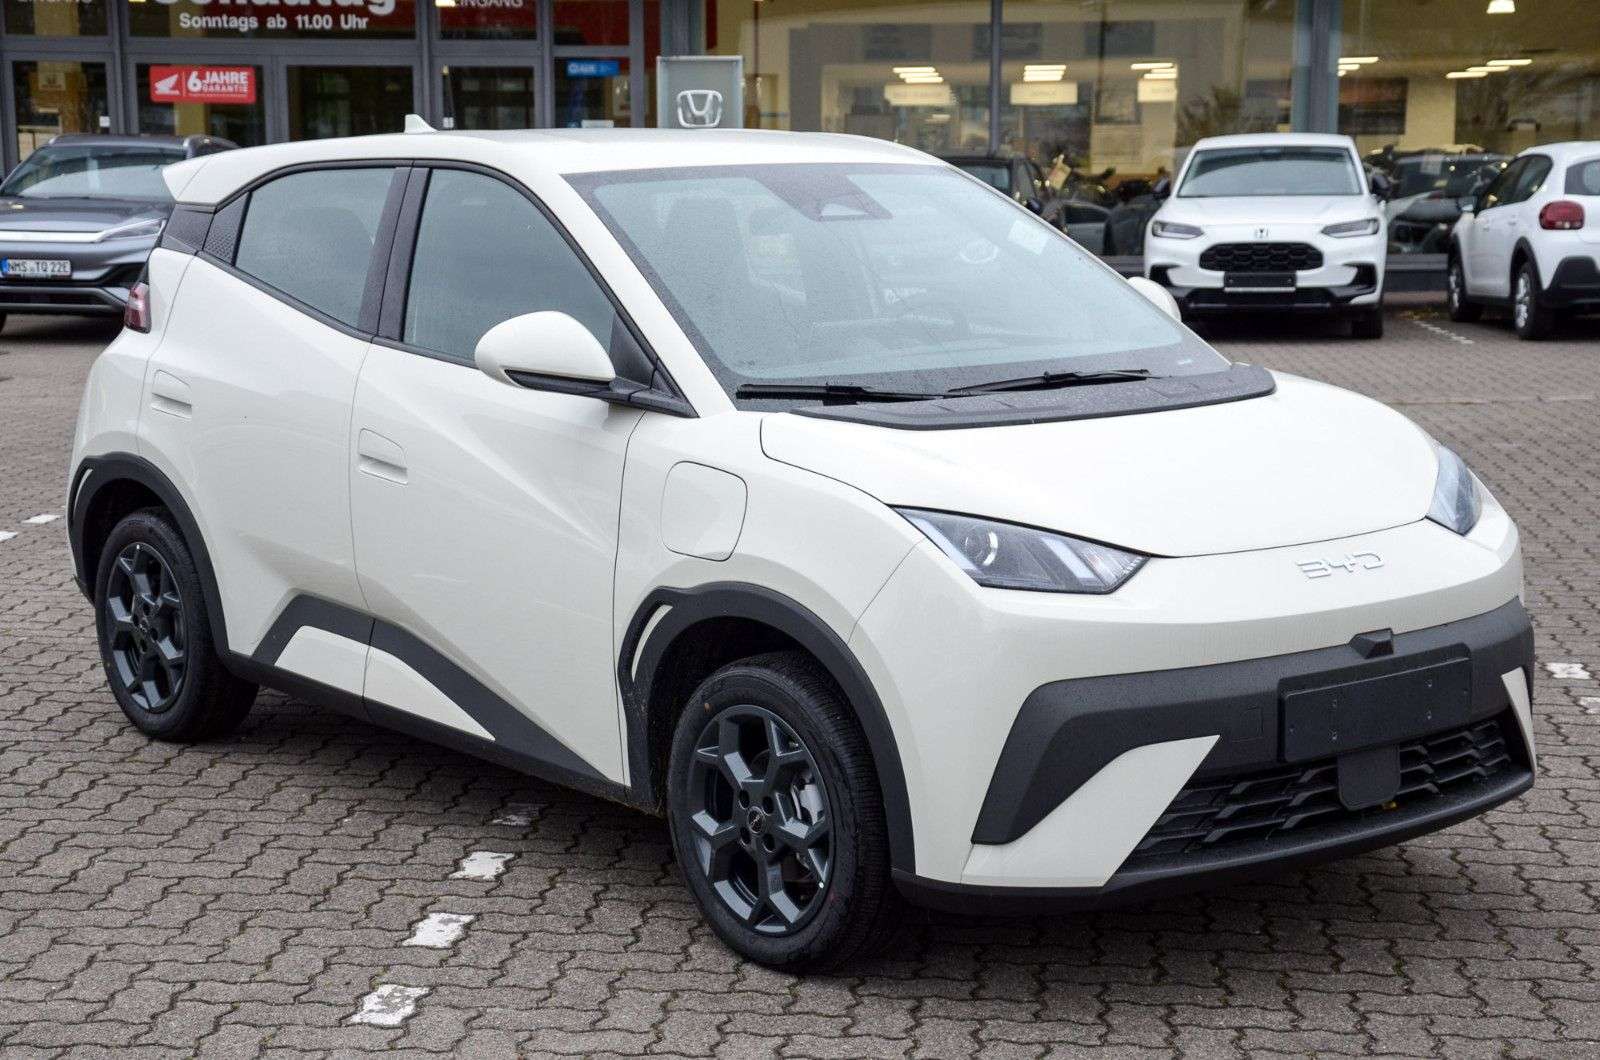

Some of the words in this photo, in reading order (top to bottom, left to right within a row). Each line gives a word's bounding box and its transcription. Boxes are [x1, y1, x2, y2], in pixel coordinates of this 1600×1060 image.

[179, 12, 258, 32] Sonntags
[267, 13, 287, 29] ab
[295, 14, 332, 30] 11.00
[340, 14, 369, 29] Uhr
[187, 71, 202, 92] 6
[204, 71, 249, 84] JAHRE
[202, 84, 249, 93] GARANTIE
[1295, 552, 1384, 579] BYD
